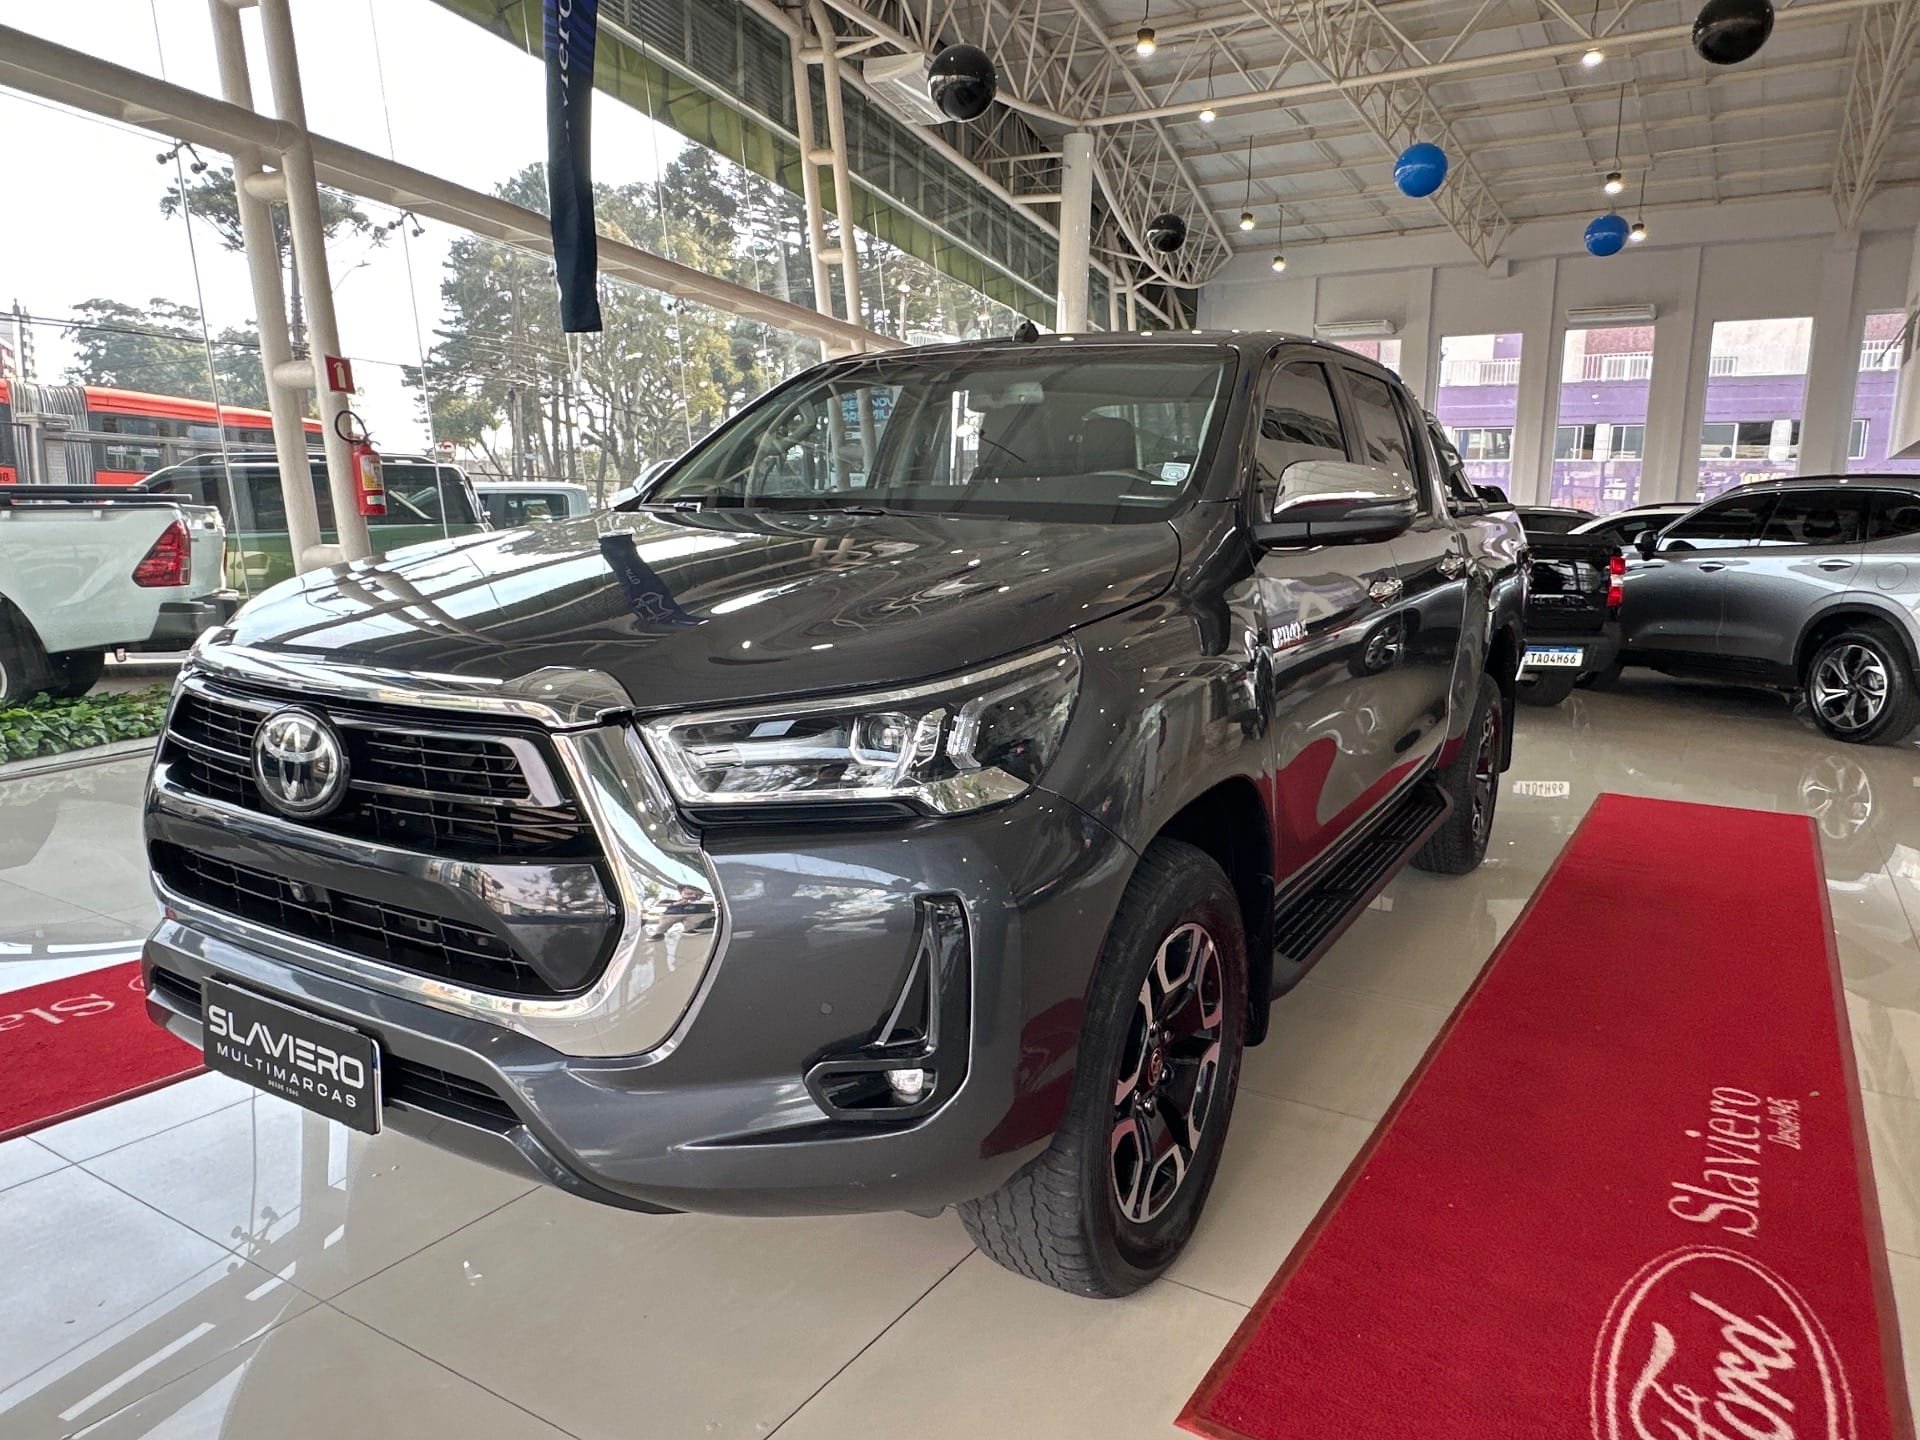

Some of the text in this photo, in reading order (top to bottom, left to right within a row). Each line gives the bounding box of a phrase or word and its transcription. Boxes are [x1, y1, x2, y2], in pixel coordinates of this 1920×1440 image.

[208, 1004, 365, 1090] SLAVIERO
[216, 1042, 357, 1109] MULTIMARCAS
[1668, 1086, 1762, 1239] Slaviero
